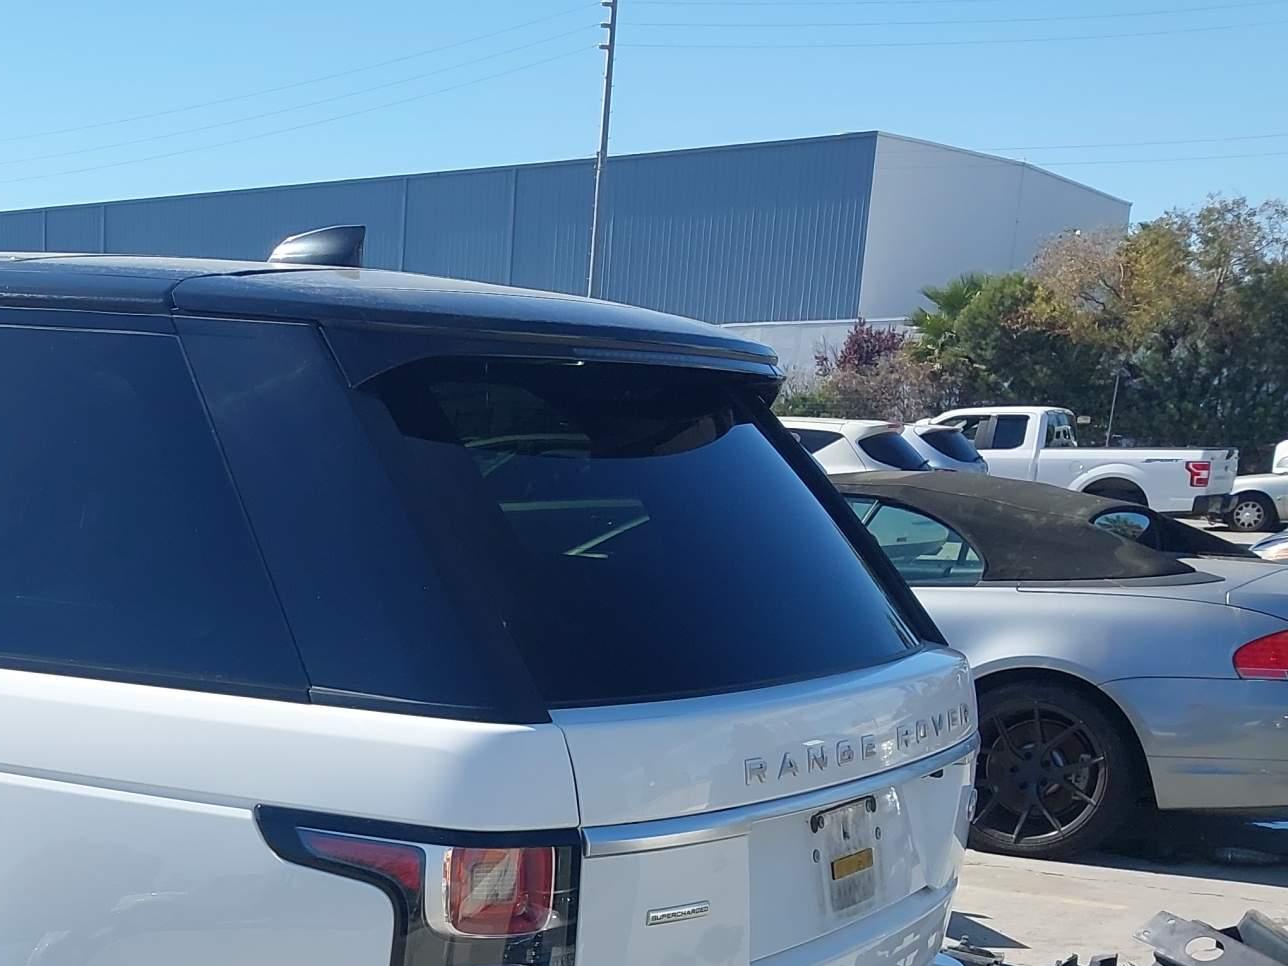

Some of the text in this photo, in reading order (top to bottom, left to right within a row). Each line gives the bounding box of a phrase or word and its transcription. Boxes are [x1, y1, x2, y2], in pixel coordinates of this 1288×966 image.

[744, 702, 969, 786] RANGE ROVER
[650, 905, 709, 921] SUPERCHARGED
